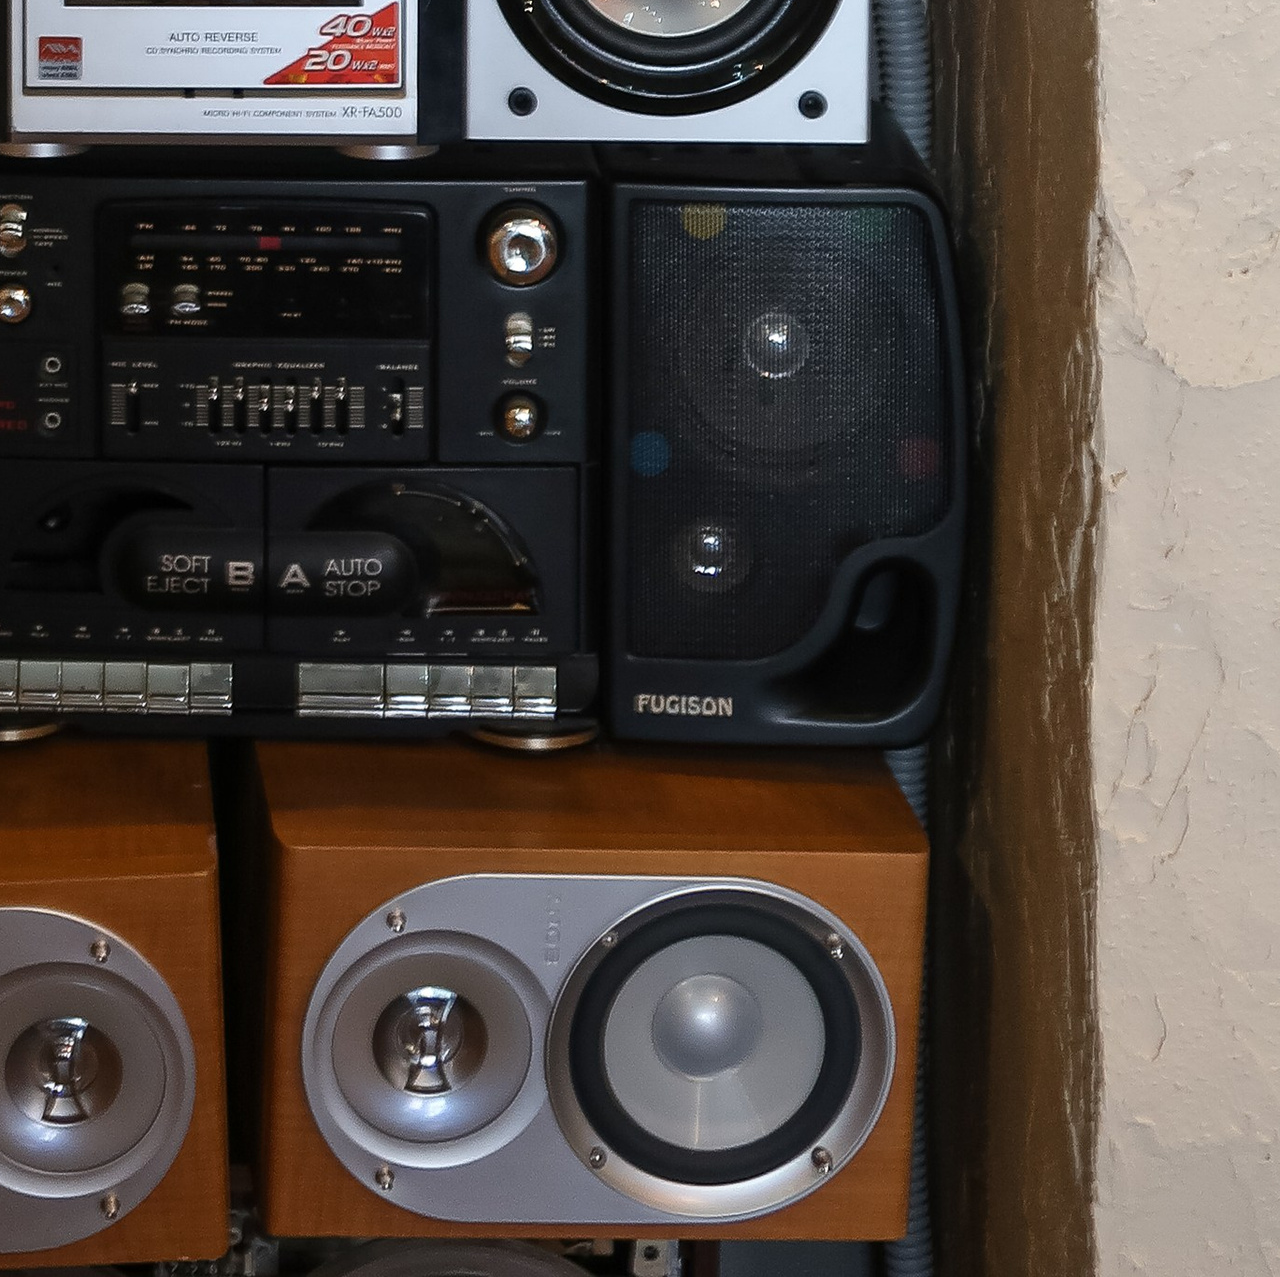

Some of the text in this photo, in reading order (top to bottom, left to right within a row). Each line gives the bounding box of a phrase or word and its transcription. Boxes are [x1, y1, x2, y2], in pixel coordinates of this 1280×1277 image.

[319, 13, 374, 37] 40
[169, 32, 259, 43] AUTO REVERSE
[201, 47, 248, 55] RECORDING
[250, 46, 282, 55] SYSTEM
[303, 48, 353, 71] 20
[341, 105, 403, 119] XR-FA500
[160, 554, 213, 574] SOFT
[226, 560, 256, 586] B
[323, 557, 384, 577] AUTO
[146, 575, 211, 594] EJECT
[279, 563, 311, 588] A
[324, 579, 381, 598] STOP
[634, 692, 734, 717] FUGISON
